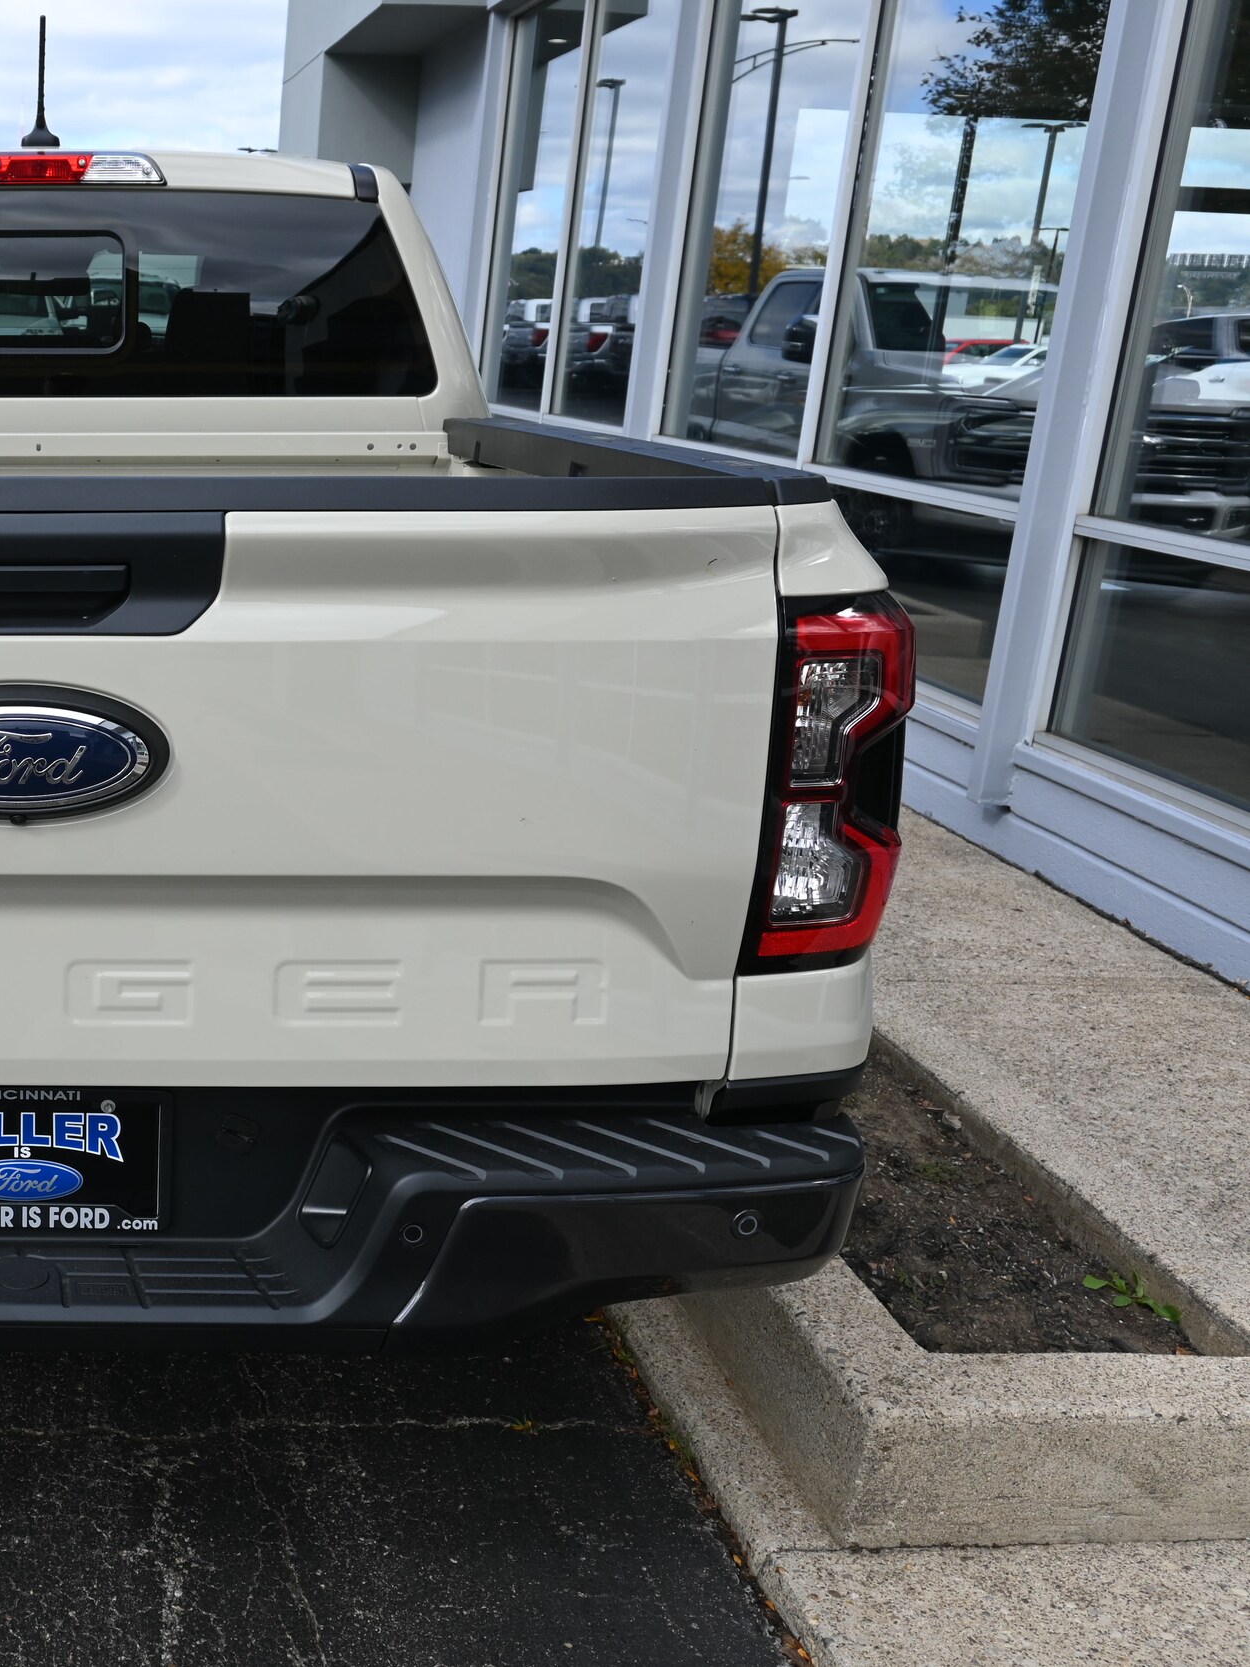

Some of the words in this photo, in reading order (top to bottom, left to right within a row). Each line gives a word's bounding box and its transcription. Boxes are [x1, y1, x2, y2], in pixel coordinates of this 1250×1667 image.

[13, 1146, 31, 1159] IS
[21, 1206, 42, 1229] IS
[49, 1206, 110, 1229] FORD
[116, 1219, 158, 1231] .com
